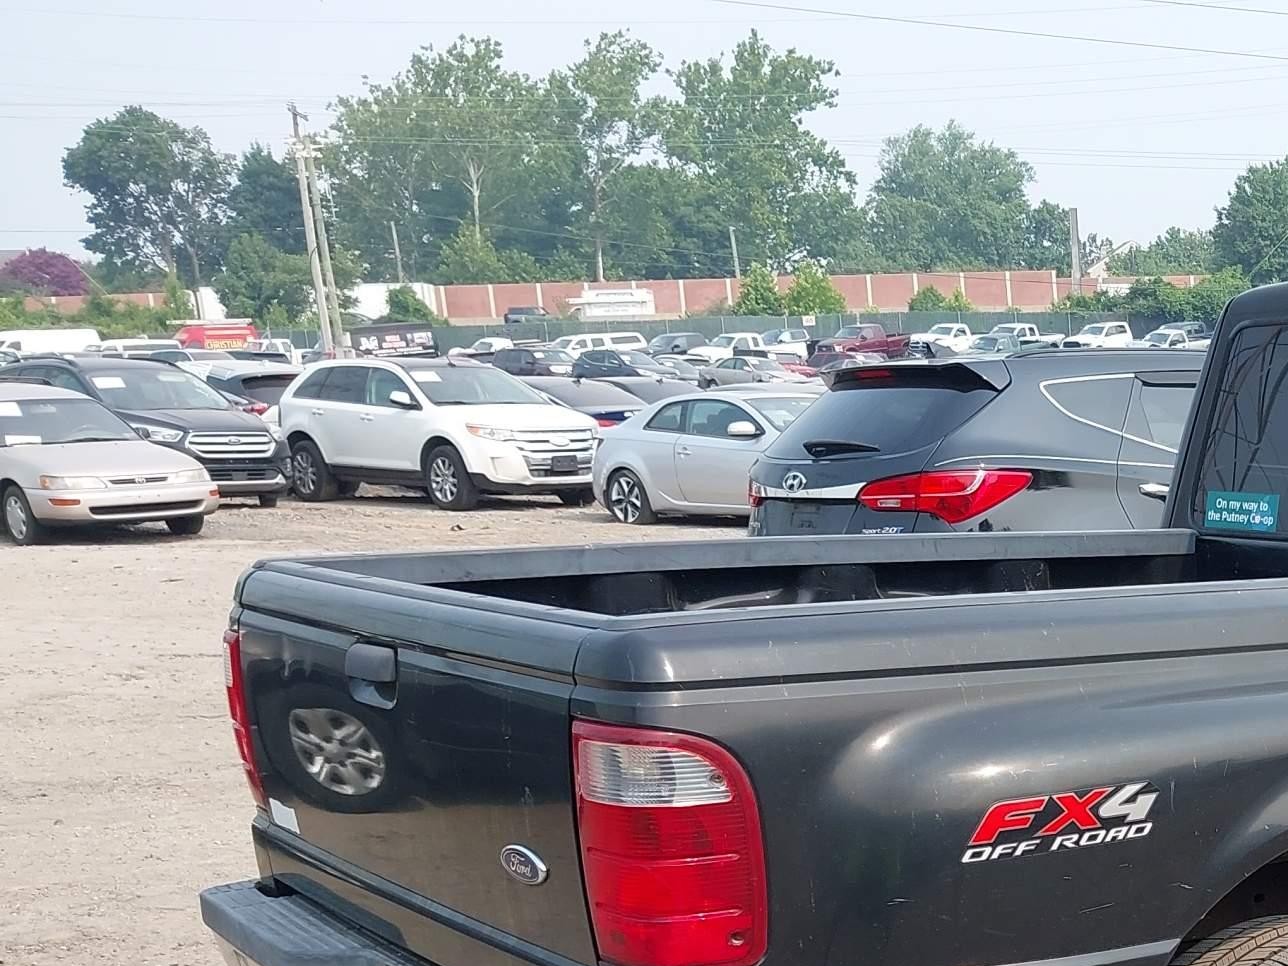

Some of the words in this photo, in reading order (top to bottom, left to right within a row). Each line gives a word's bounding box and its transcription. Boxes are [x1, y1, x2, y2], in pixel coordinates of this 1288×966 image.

[1207, 510, 1221, 520] the
[1221, 511, 1249, 525] Putney
[1249, 513, 1274, 526] Co-op
[1215, 498, 1228, 509] On
[1228, 501, 1241, 511] my
[1242, 502, 1258, 512] way
[1259, 501, 1269, 511] to
[968, 781, 1160, 846] FX4
[961, 838, 1042, 863] OFF
[1049, 822, 1153, 851] ROAD
